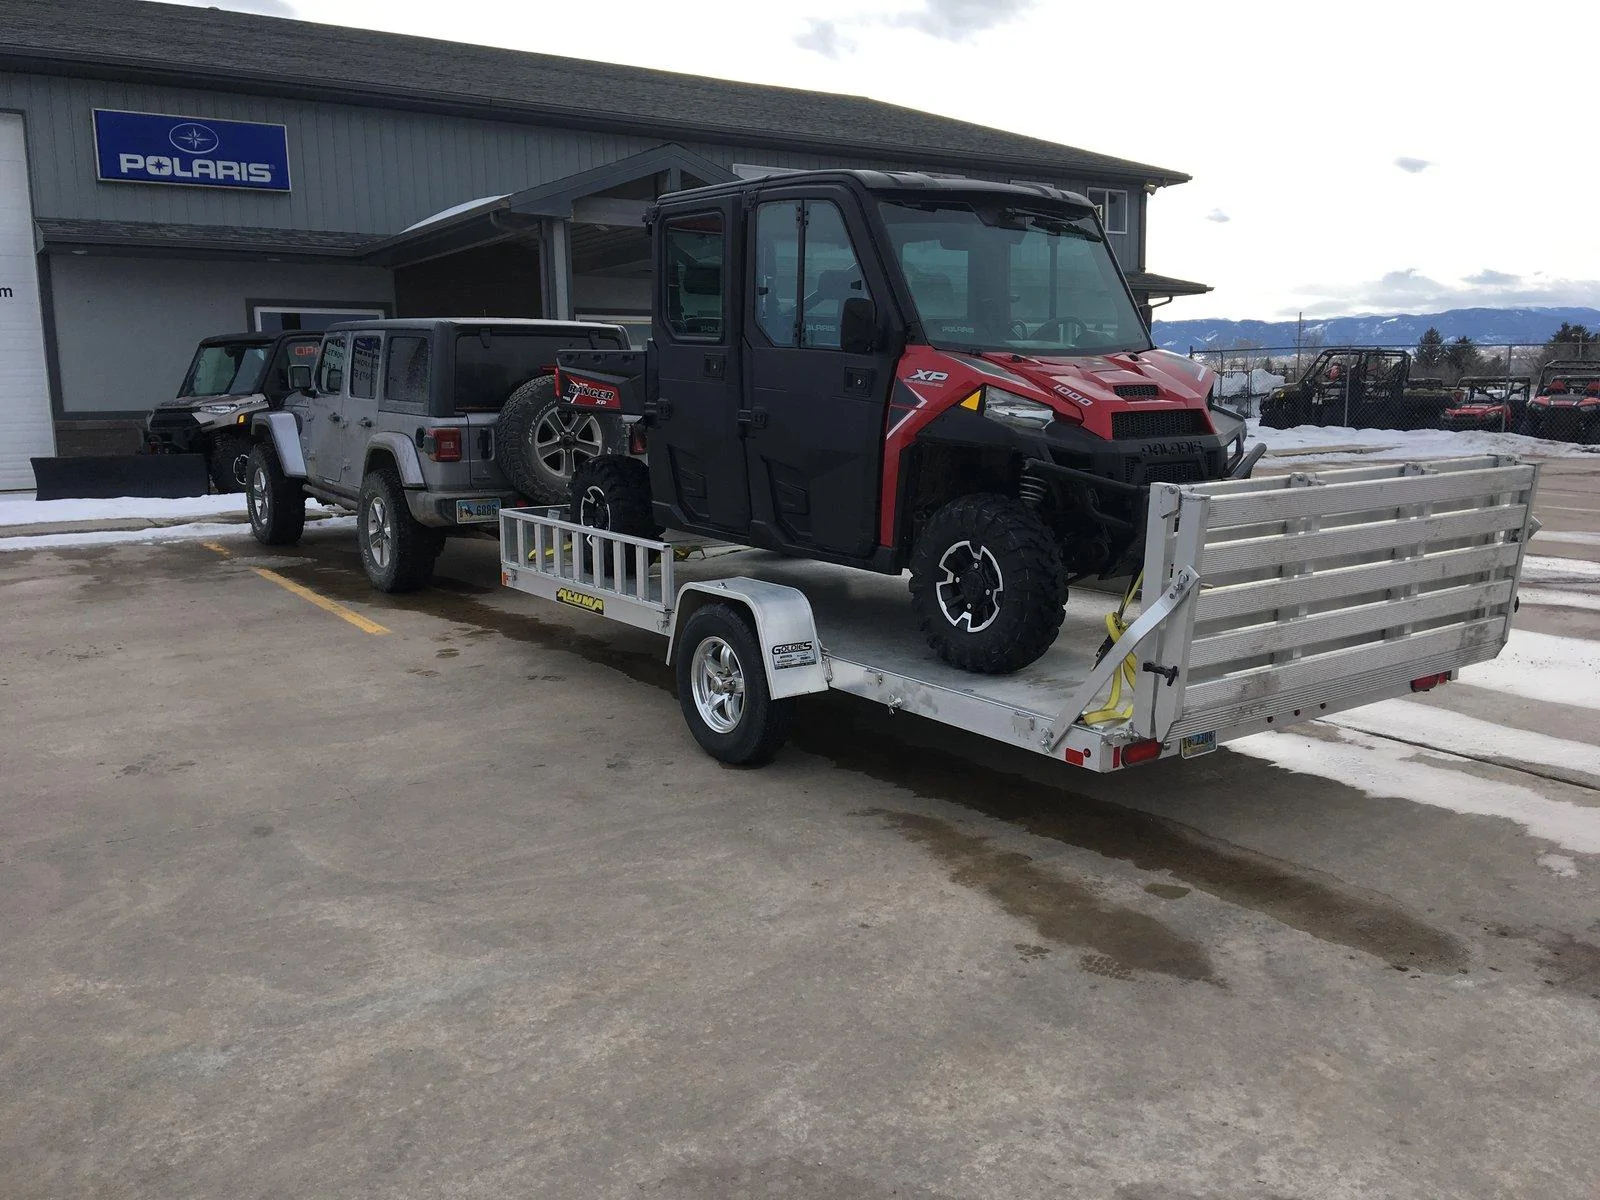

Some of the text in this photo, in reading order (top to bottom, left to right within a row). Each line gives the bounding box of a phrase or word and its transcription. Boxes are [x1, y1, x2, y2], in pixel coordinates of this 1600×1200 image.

[119, 153, 271, 183] POLARIS
[942, 326, 975, 334] POLARIS
[909, 369, 949, 381] XP
[568, 383, 615, 400] RANGER
[1053, 384, 1094, 407] 1000
[1141, 440, 1204, 456] POLARIS
[557, 588, 604, 611] ALUMA
